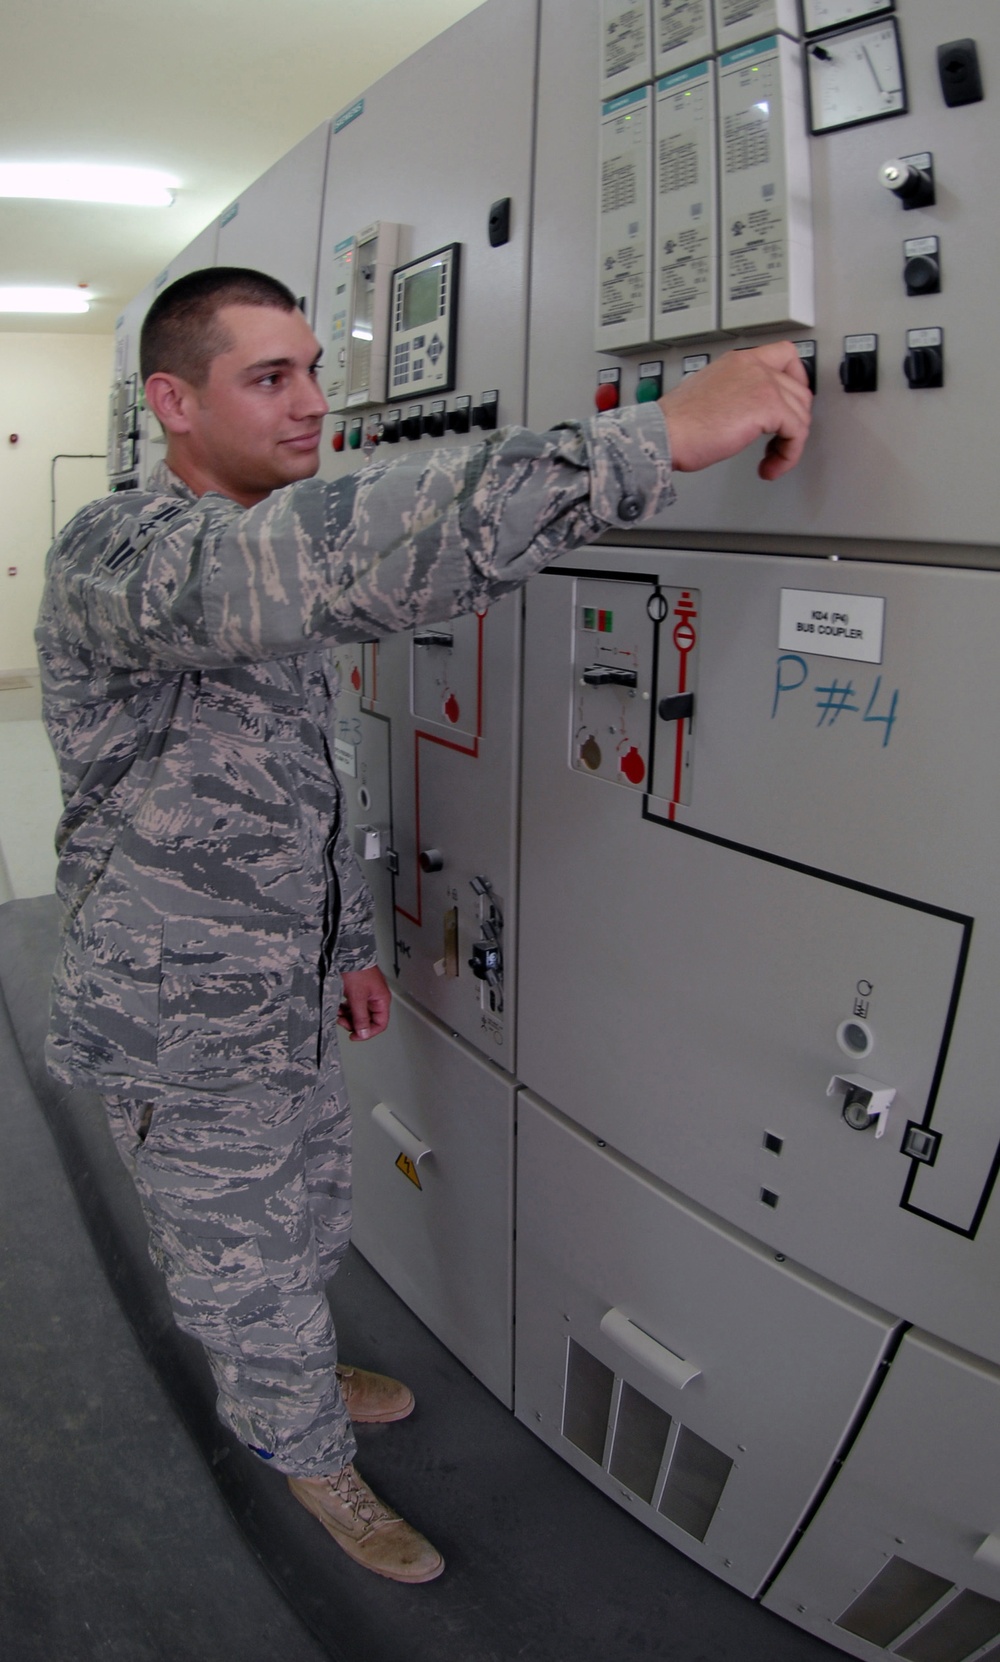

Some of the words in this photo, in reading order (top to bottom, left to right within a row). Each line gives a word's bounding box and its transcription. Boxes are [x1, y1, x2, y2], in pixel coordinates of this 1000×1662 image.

[830, 612, 849, 625] (P4)
[796, 622, 815, 633] BUS
[817, 624, 863, 640] COUPLER
